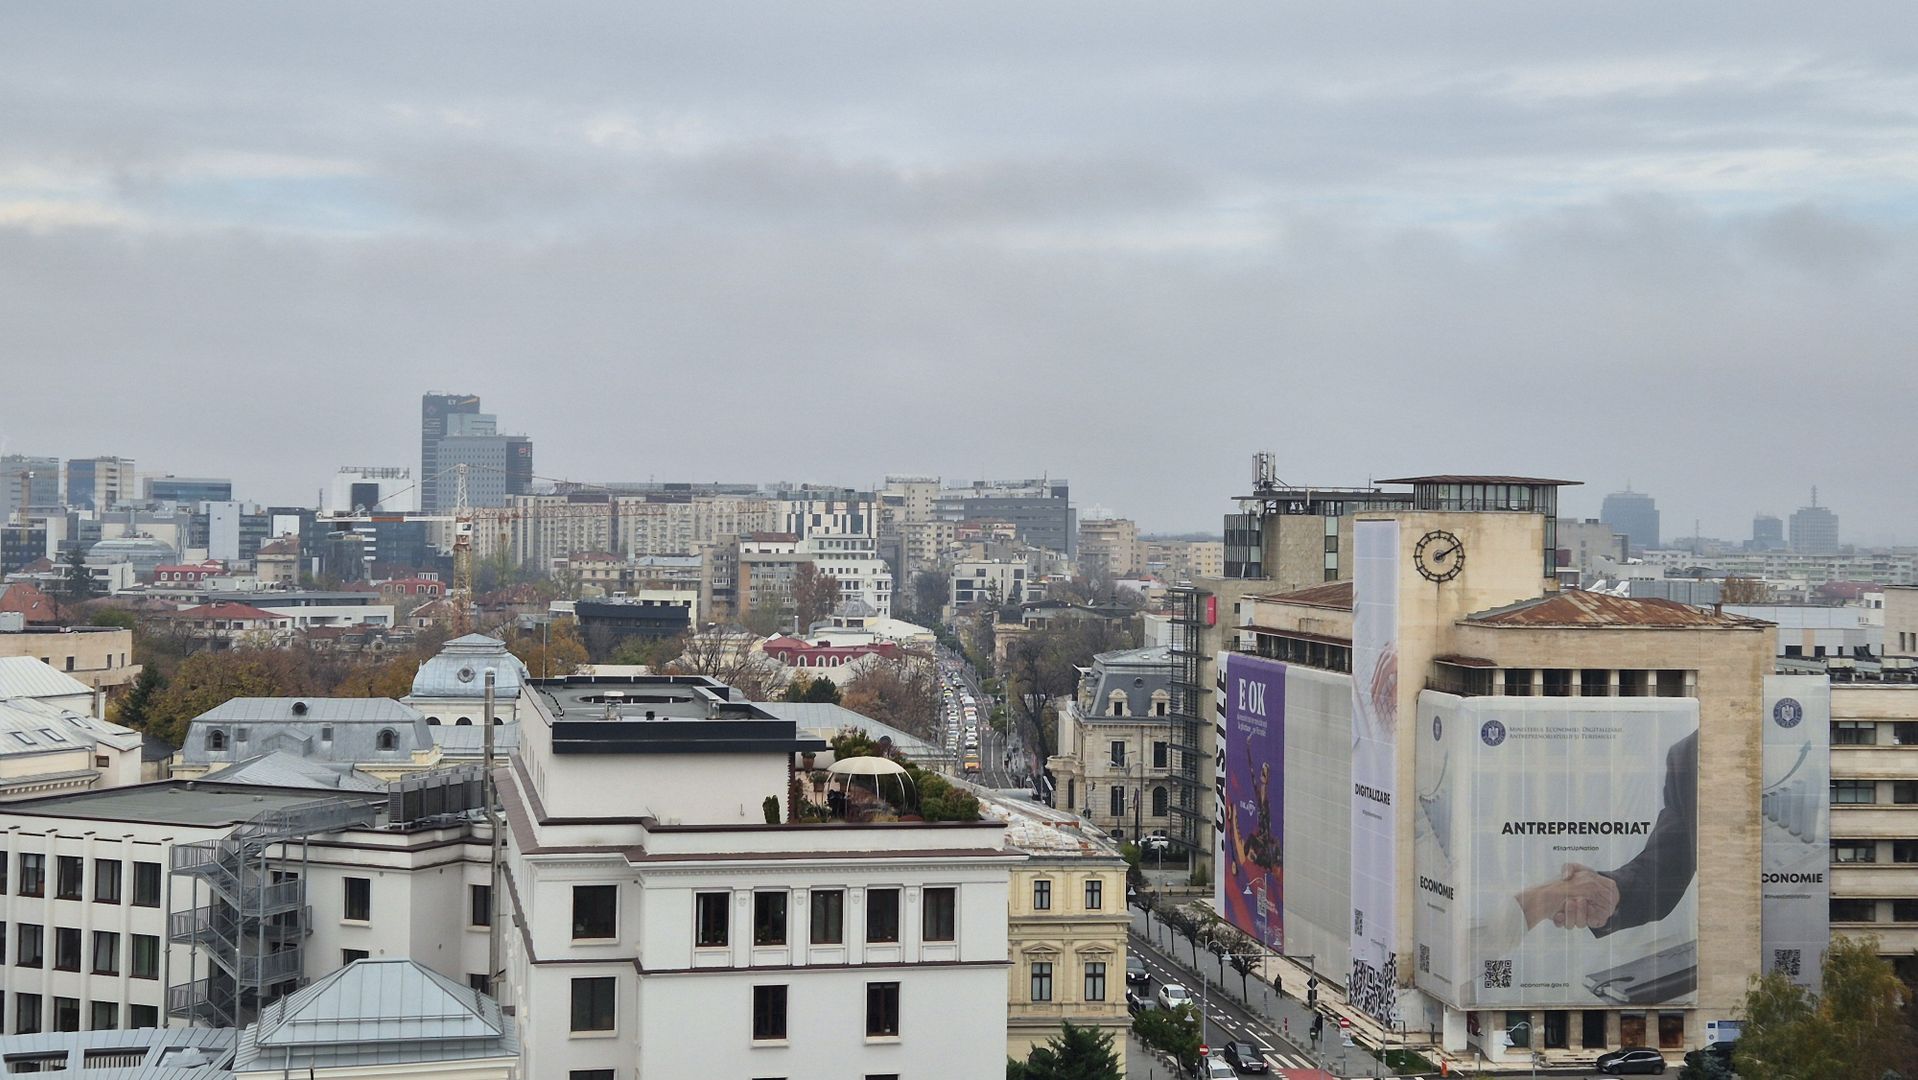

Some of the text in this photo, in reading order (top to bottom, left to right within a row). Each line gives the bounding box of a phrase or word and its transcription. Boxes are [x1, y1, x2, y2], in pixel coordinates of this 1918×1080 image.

[1238, 678, 1267, 717] E OK
[1354, 783, 1391, 806] DIGITALIZARE
[1501, 821, 1651, 835] ANTREPRENORIAT
[1419, 875, 1454, 901] ECONOMIE
